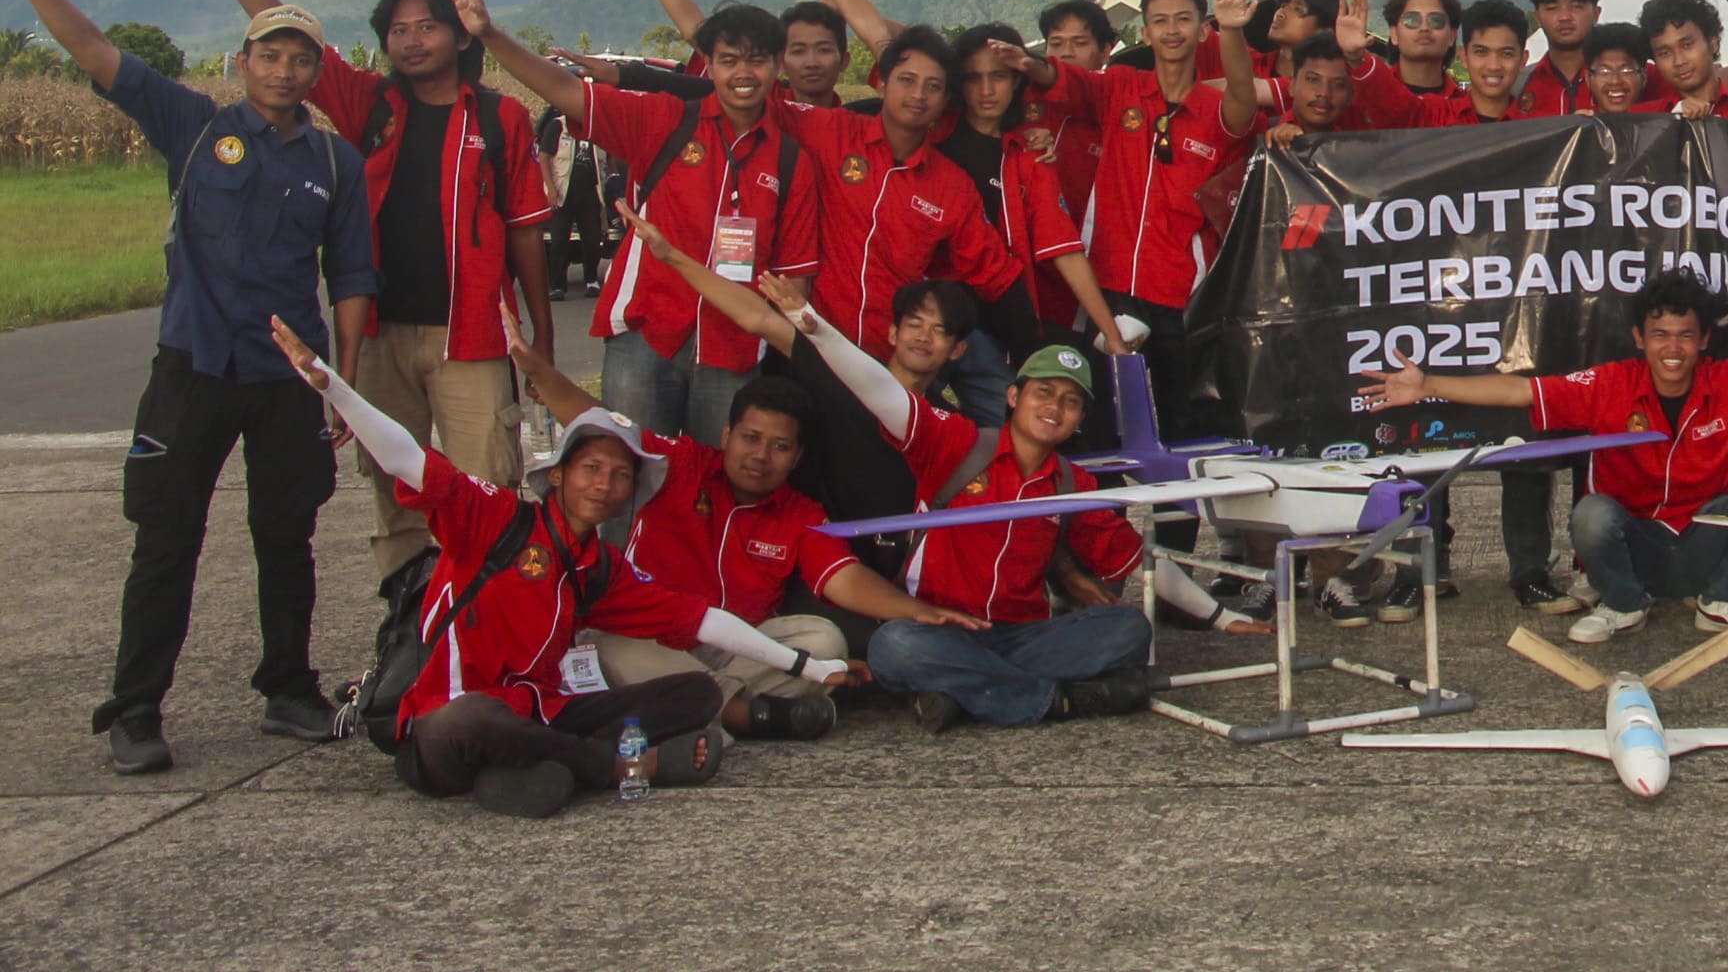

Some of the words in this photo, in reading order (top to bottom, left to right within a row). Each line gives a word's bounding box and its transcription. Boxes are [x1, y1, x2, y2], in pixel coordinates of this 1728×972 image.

[1343, 184, 1595, 246] KONTES
[1343, 249, 1646, 308] TERBANG
[1346, 321, 1502, 375] 2025
